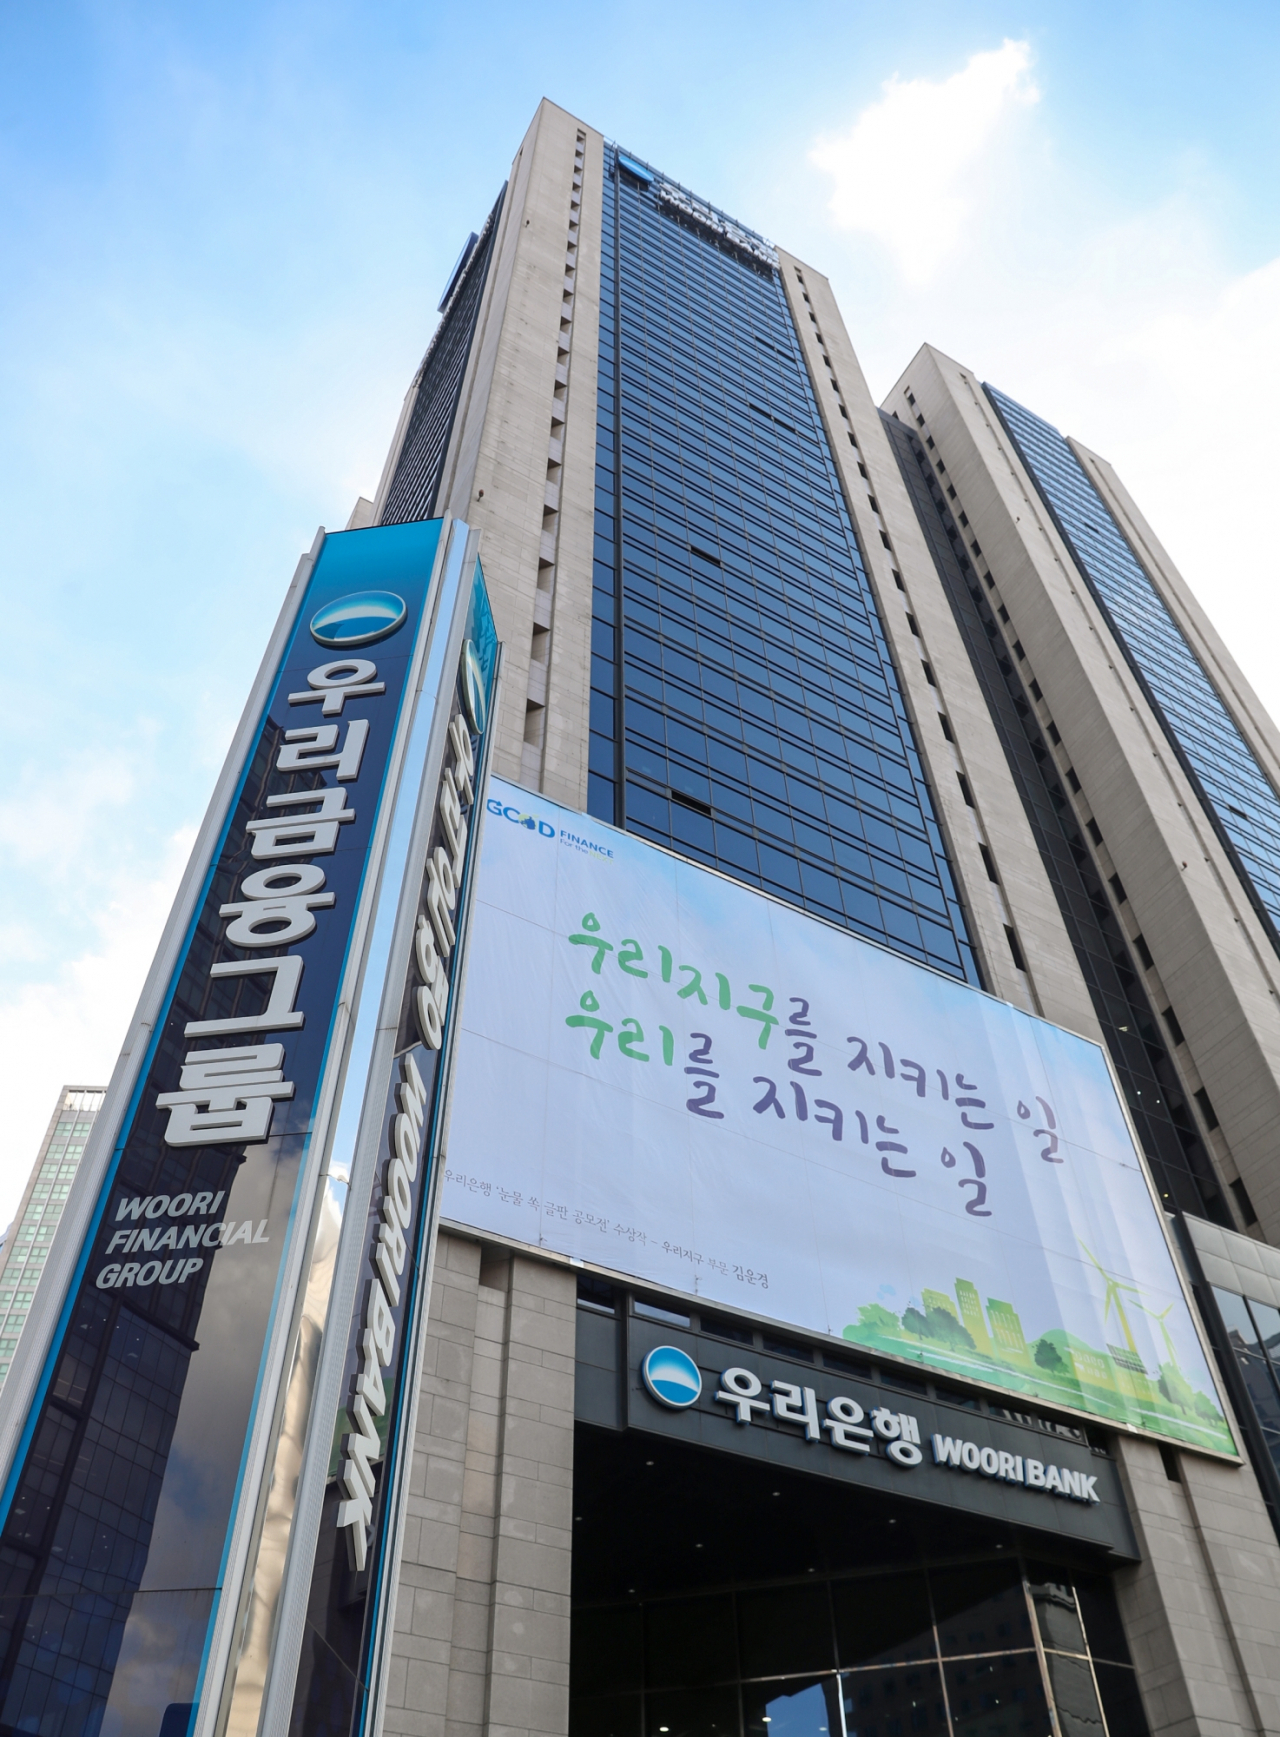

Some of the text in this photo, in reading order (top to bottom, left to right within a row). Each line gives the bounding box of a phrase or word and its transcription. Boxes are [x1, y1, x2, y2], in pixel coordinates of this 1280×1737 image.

[412, 713, 474, 1050] 우리은행
[560, 830, 614, 858] FINANCE
[560, 838, 614, 865] For the NEXT
[156, 659, 386, 1147] 우리금융그룹
[568, 912, 1064, 1164] 우리지구를 지키는 일
[565, 990, 992, 1216] 우리를 지키는 일
[105, 1219, 270, 1255] FINANCIAL
[115, 1191, 226, 1222] WOORI
[444, 1169, 492, 1197] 우리은행
[544, 1201, 568, 1220] 글판
[613, 1223, 647, 1246] 수상작
[661, 1241, 704, 1265] 우리지구
[707, 1257, 729, 1276] 부문
[732, 1264, 769, 1289] 김운경
[96, 1258, 204, 1289] GROUP
[715, 1366, 923, 1468] 우리은행
